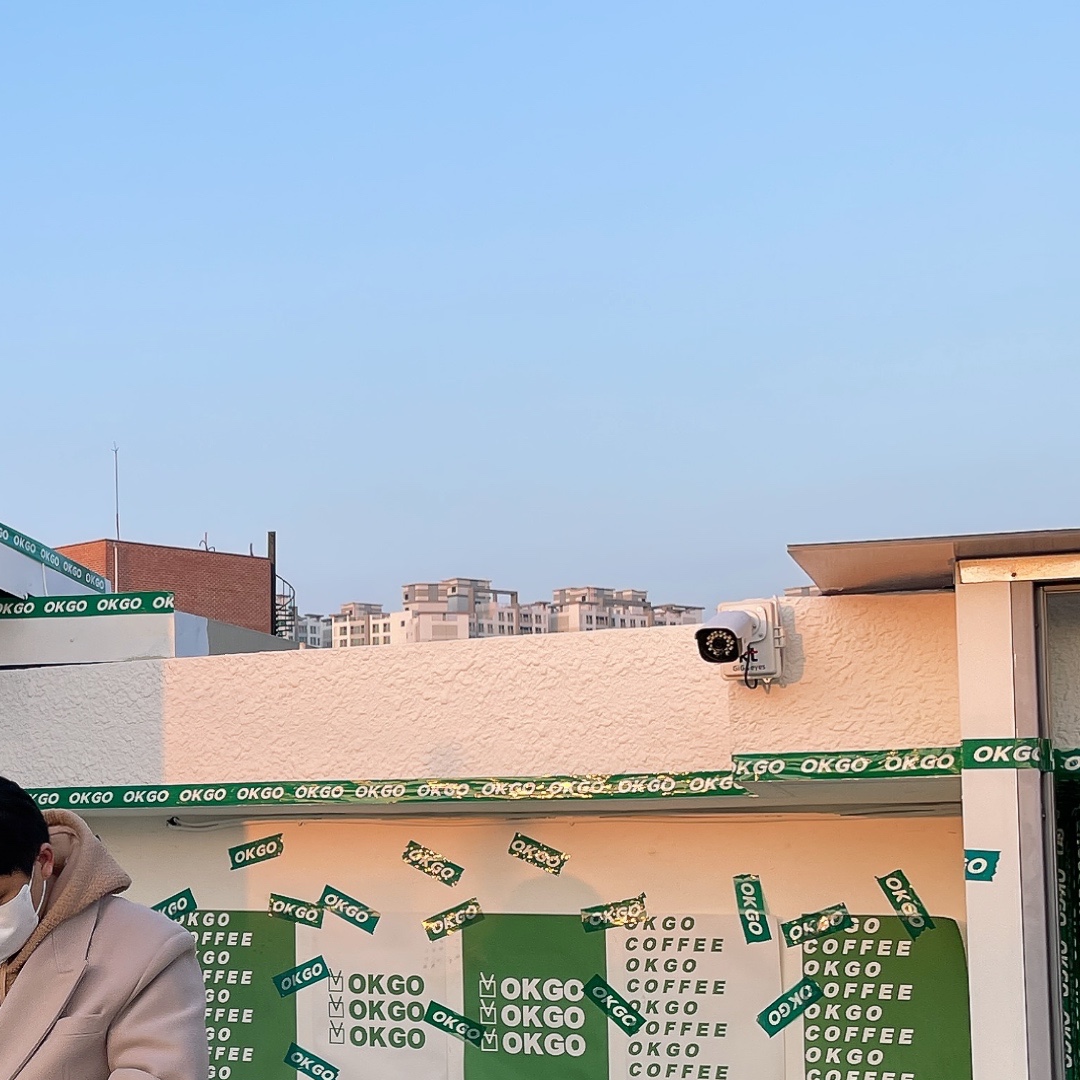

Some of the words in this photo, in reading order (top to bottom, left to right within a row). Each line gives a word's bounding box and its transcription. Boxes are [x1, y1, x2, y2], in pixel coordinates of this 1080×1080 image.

[13, 535, 36, 554] OKGO
[40, 548, 60, 567] OKGO
[63, 561, 82, 579] OKGO
[85, 572, 105, 590] OKGO
[44, 600, 87, 613] OKGO
[96, 598, 142, 611] OKGO
[733, 664, 766, 672] GiGeyes
[801, 757, 870, 773] OKGO
[884, 754, 955, 770] OKGO
[68, 791, 113, 803] OKGO
[123, 789, 170, 802] OKGO
[179, 788, 226, 801] OKGO
[236, 786, 285, 799] OKGO
[295, 785, 344, 799] OKGO
[355, 784, 405, 799] OKGO
[417, 783, 470, 798] OKGO
[482, 781, 536, 795] OKGO
[548, 780, 604, 794] OKGO
[618, 778, 676, 793] OKGO
[234, 840, 278, 863] OKGO
[511, 839, 560, 867] OKGO
[324, 893, 369, 922] OKGO
[741, 882, 763, 936] OKGO
[625, 937, 724, 953] COFFEE
[803, 940, 912, 957] COFFEE
[280, 962, 323, 991] OKGO
[626, 958, 697, 973] OKGO
[803, 960, 881, 978] OKGO
[348, 973, 425, 996] OKGO
[500, 977, 585, 1002] OKGO
[627, 979, 726, 995] COFFEE
[348, 999, 425, 1022] OKGO
[592, 986, 637, 1028] OKGO
[768, 984, 813, 1026] OKGO
[804, 1004, 882, 1021] OKGO
[432, 1011, 481, 1039] OKGO
[500, 1005, 586, 1029] OKGO
[349, 1025, 426, 1049] OKGO
[502, 1031, 587, 1057] OKGO
[805, 1026, 914, 1045] COFFEE
[628, 1042, 700, 1058] OKGO
[805, 1048, 884, 1066] OKGO
[290, 1052, 335, 1080] OKGO
[629, 1063, 729, 1080] COFFEE
